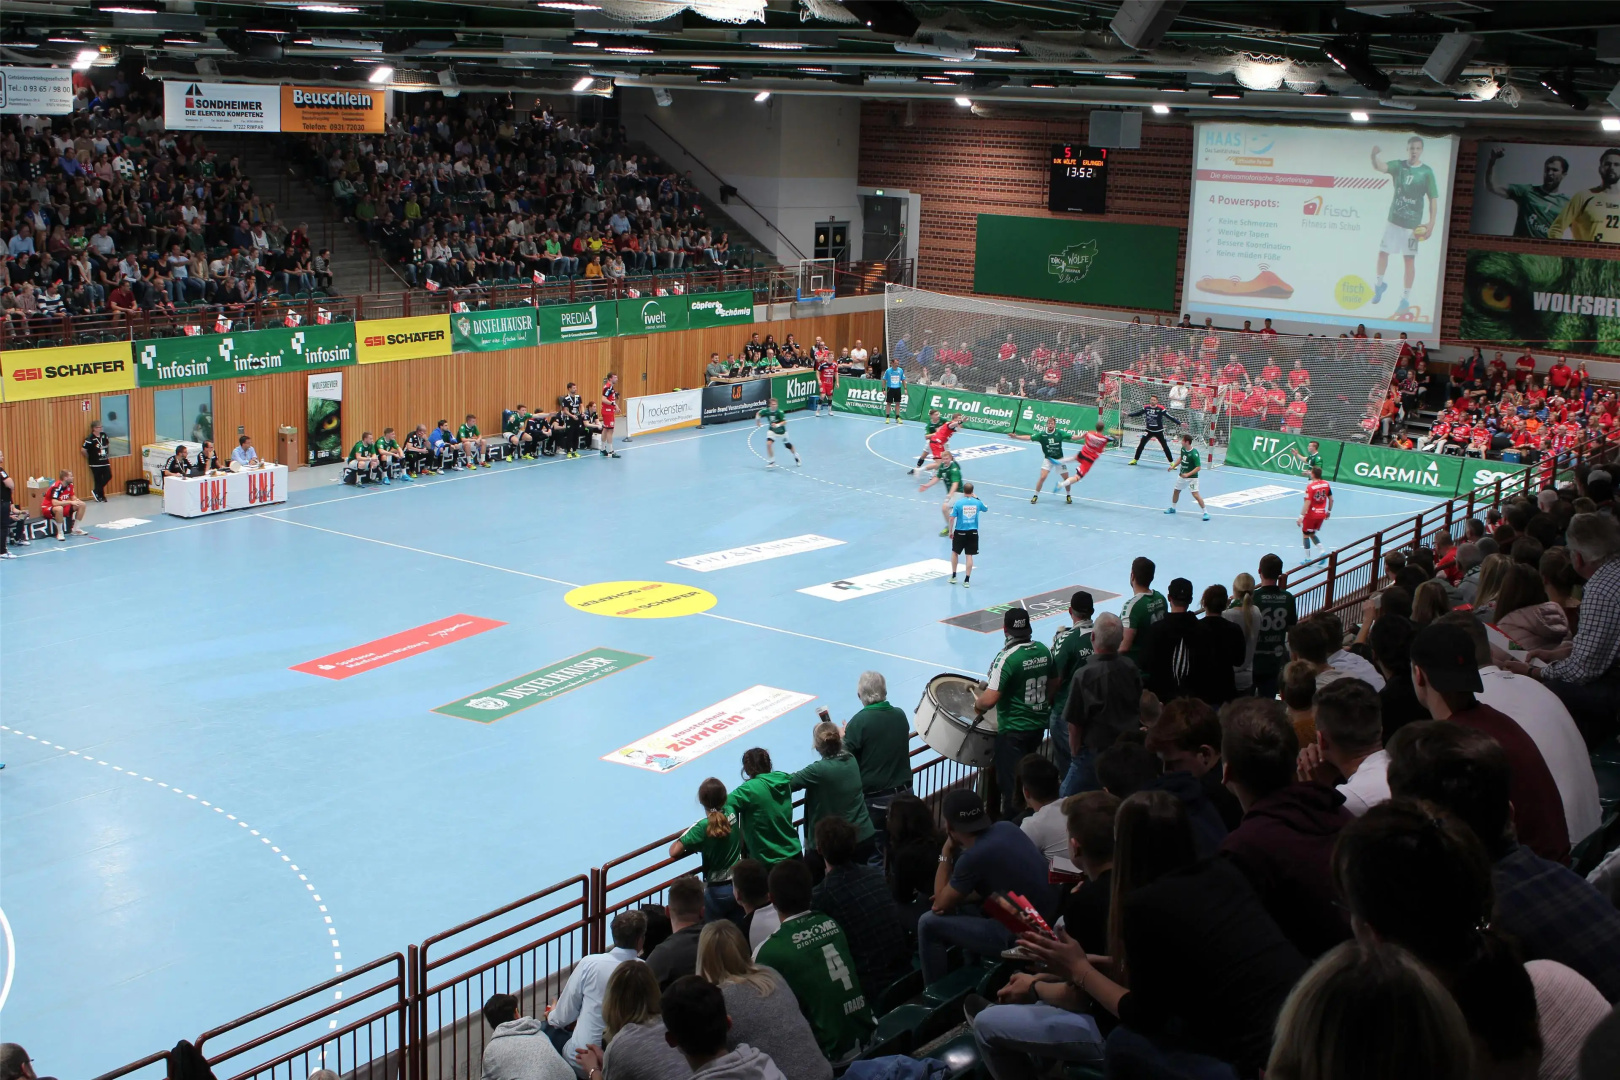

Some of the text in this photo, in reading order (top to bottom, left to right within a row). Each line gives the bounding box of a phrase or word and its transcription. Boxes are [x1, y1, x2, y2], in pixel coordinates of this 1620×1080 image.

[196, 99, 262, 110] SONDHEIMER
[293, 90, 372, 108] Beuschlein
[1205, 131, 1241, 146] HAAS
[1064, 147, 1072, 158] 5
[1101, 148, 1107, 159] 7
[1222, 174, 1273, 182] sensomotorische
[1274, 176, 1314, 184] Sporteinlage
[1209, 195, 1280, 208] 4 Powerspots:
[1218, 218, 1278, 228] Keine Schmerzen
[1302, 218, 1361, 232] Fitness im Schuh
[1606, 215, 1619, 228] 22
[1218, 228, 1270, 240] Weniger Tapen
[1217, 239, 1292, 251] Bessere Koordination
[1067, 253, 1089, 264] WÖLFE
[1216, 250, 1281, 260] Keine müden Füße
[1342, 281, 1364, 294] fisch
[644, 309, 666, 324] iwelt
[720, 306, 750, 317] Schömig
[474, 316, 533, 334] DISTELHÄUSER
[364, 330, 444, 347] SSI SCHÄFER
[13, 360, 124, 381] SSI SCHÄFER
[786, 377, 816, 398] Kham
[648, 401, 688, 417] rockenstein
[930, 396, 943, 408] E.
[948, 398, 980, 413] Troll
[982, 406, 1014, 418] GmbH
[1252, 436, 1280, 454] FIT
[1354, 462, 1438, 487] GARMIN
[1314, 488, 1326, 500] 44
[1261, 608, 1288, 632] 68
[497, 657, 618, 700] DISTELHÄUSER
[672, 711, 726, 738] Haustechnik
[666, 714, 745, 752] zürrlein
[960, 808, 981, 818] RVCA
[792, 920, 837, 944] SCHÖMIG
[822, 943, 853, 991] 4
